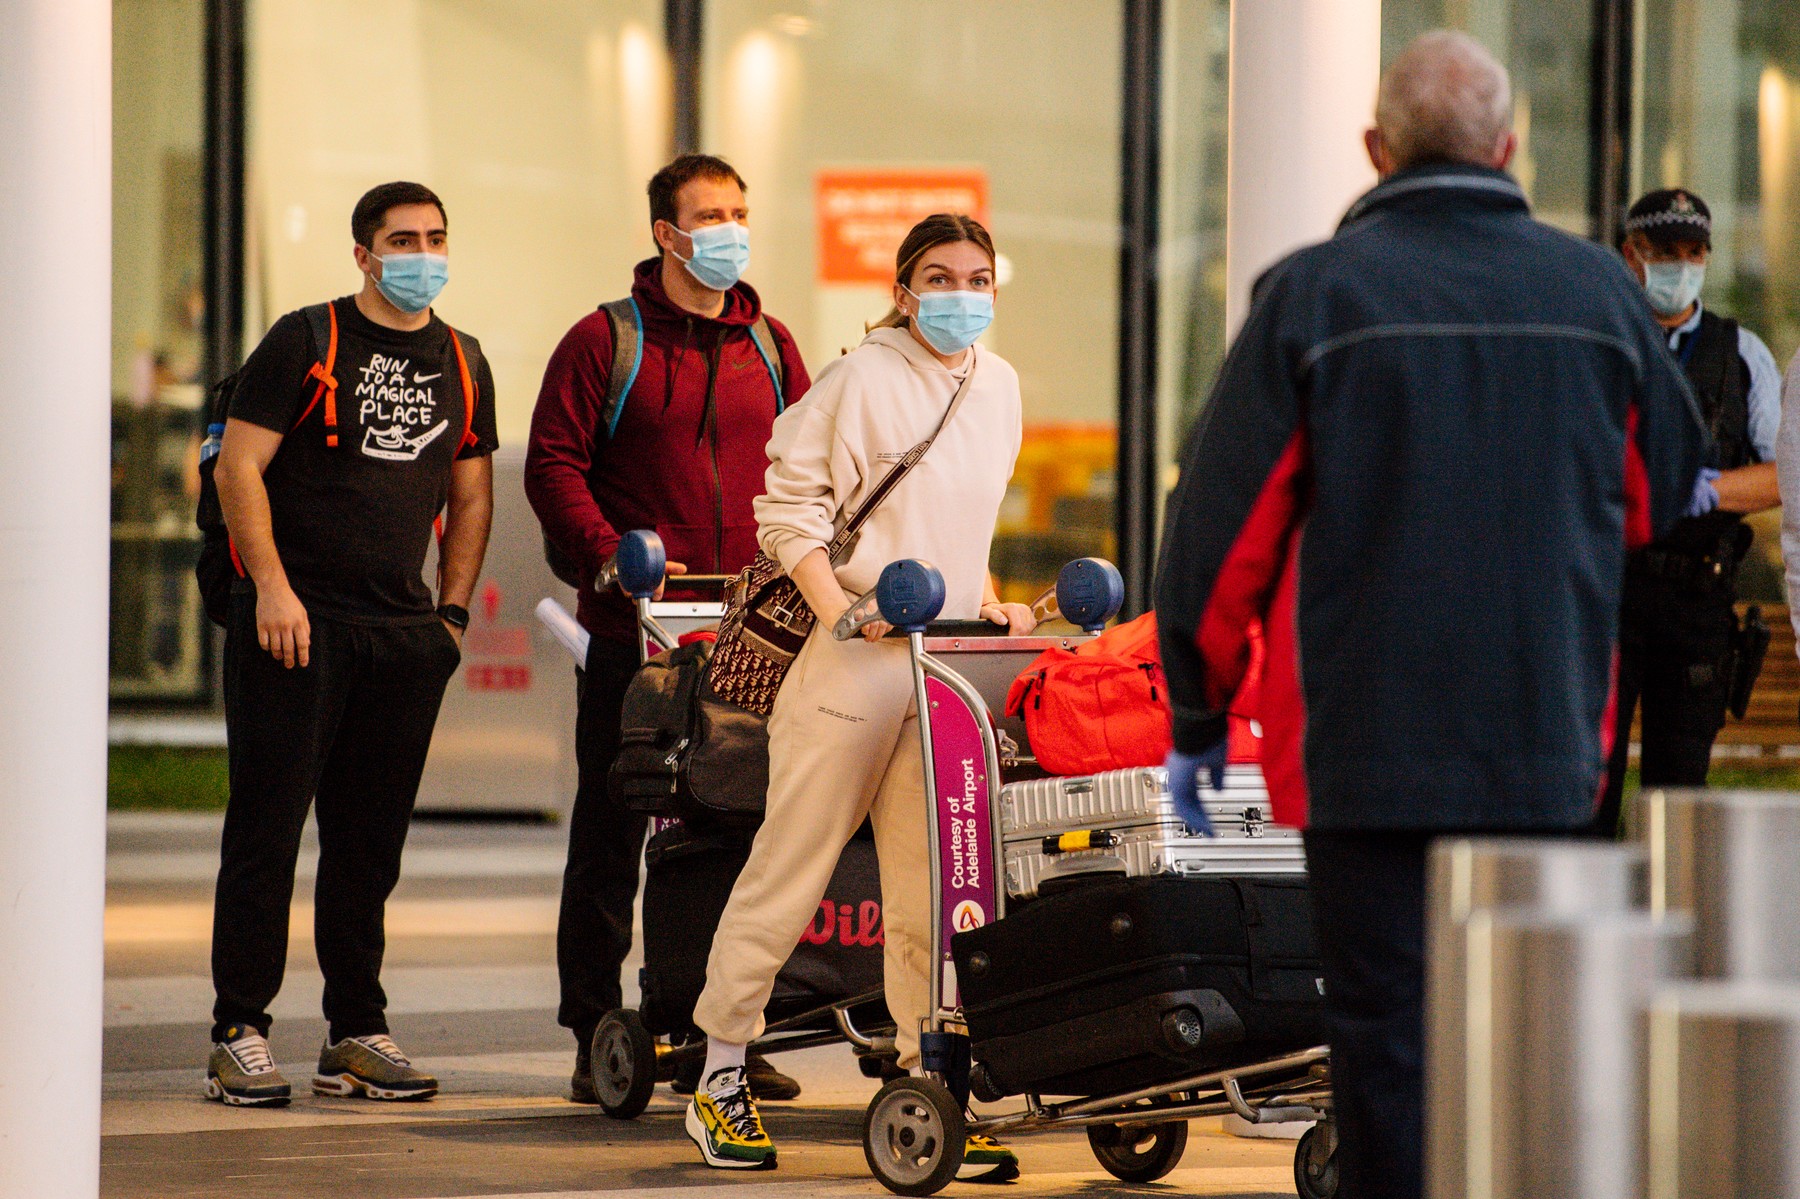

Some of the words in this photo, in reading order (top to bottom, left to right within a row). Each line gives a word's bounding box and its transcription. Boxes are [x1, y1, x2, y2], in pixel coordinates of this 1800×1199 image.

[370, 353, 410, 373] RUN
[359, 366, 385, 385] TO
[389, 373, 406, 387] A
[355, 382, 437, 406] MAGICAL
[360, 399, 432, 425] PLACE
[837, 529, 851, 545] DIOR
[961, 758, 977, 814] Airport
[947, 796, 960, 812] of
[951, 815, 965, 889] Courtesy
[964, 818, 981, 889] Adelaide
[799, 899, 886, 947] Wil
